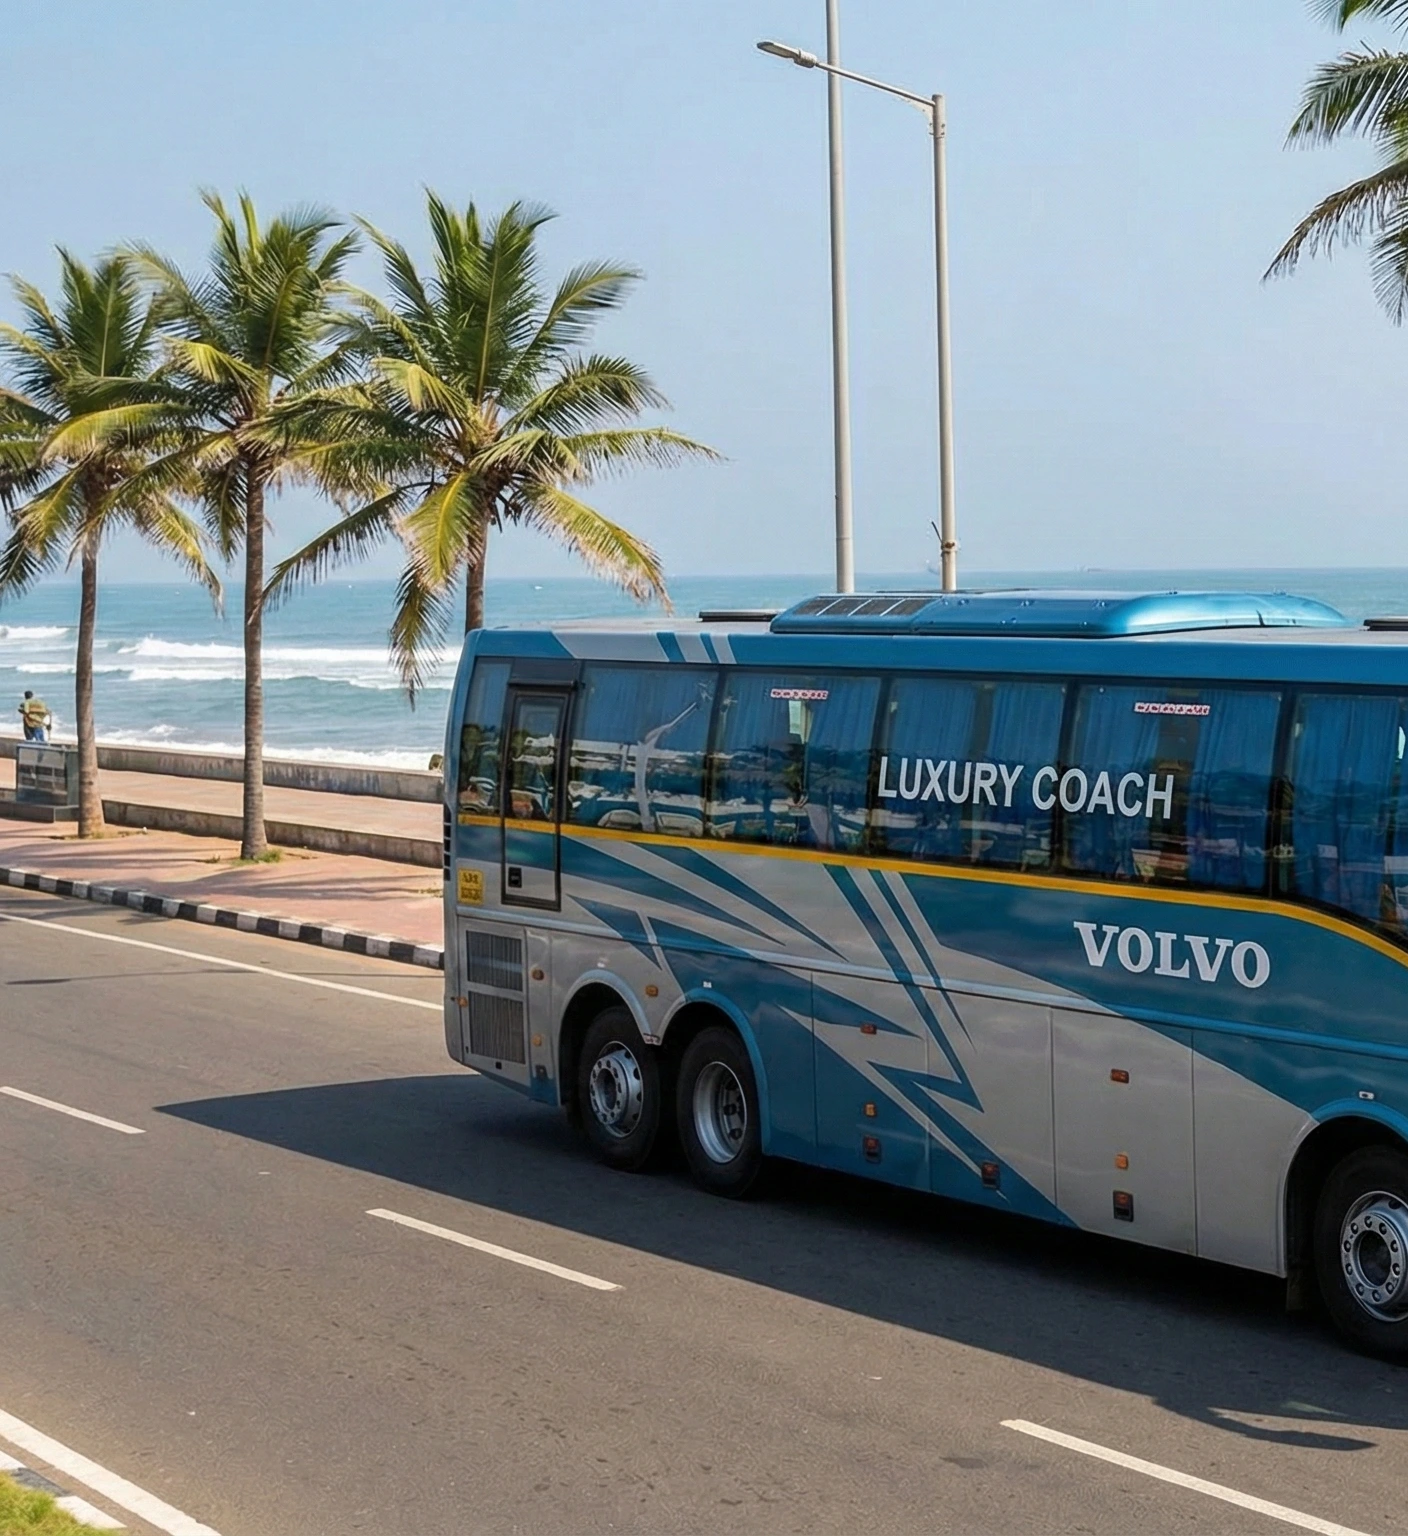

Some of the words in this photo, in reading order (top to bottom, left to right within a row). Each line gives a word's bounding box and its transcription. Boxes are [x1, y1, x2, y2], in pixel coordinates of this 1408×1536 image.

[878, 756, 1023, 807] LUXURY
[1032, 766, 1174, 819] COACH
[1073, 921, 1270, 988] VOLVO
